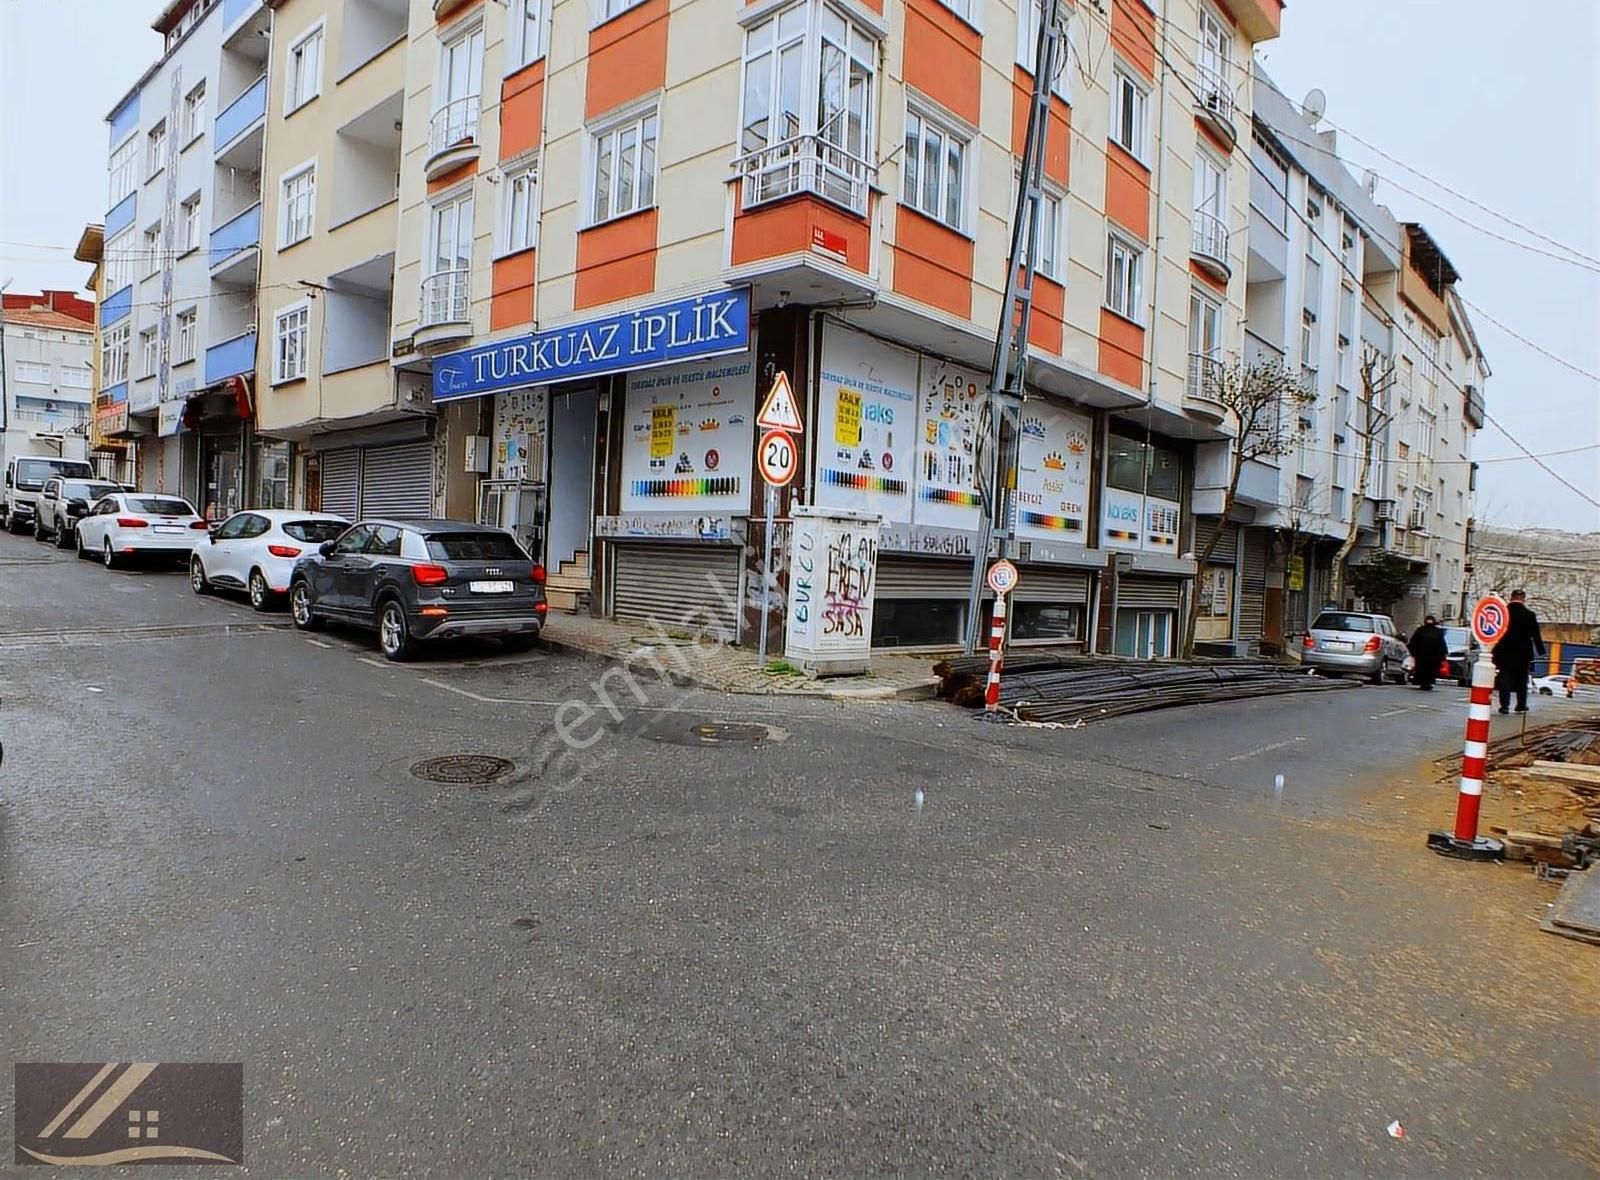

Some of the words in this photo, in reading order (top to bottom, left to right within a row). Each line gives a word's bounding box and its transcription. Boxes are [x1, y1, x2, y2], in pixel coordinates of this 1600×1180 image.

[471, 322, 620, 384] TURKUAZ
[630, 297, 738, 355] İPLİK
[767, 443, 790, 469] 20
